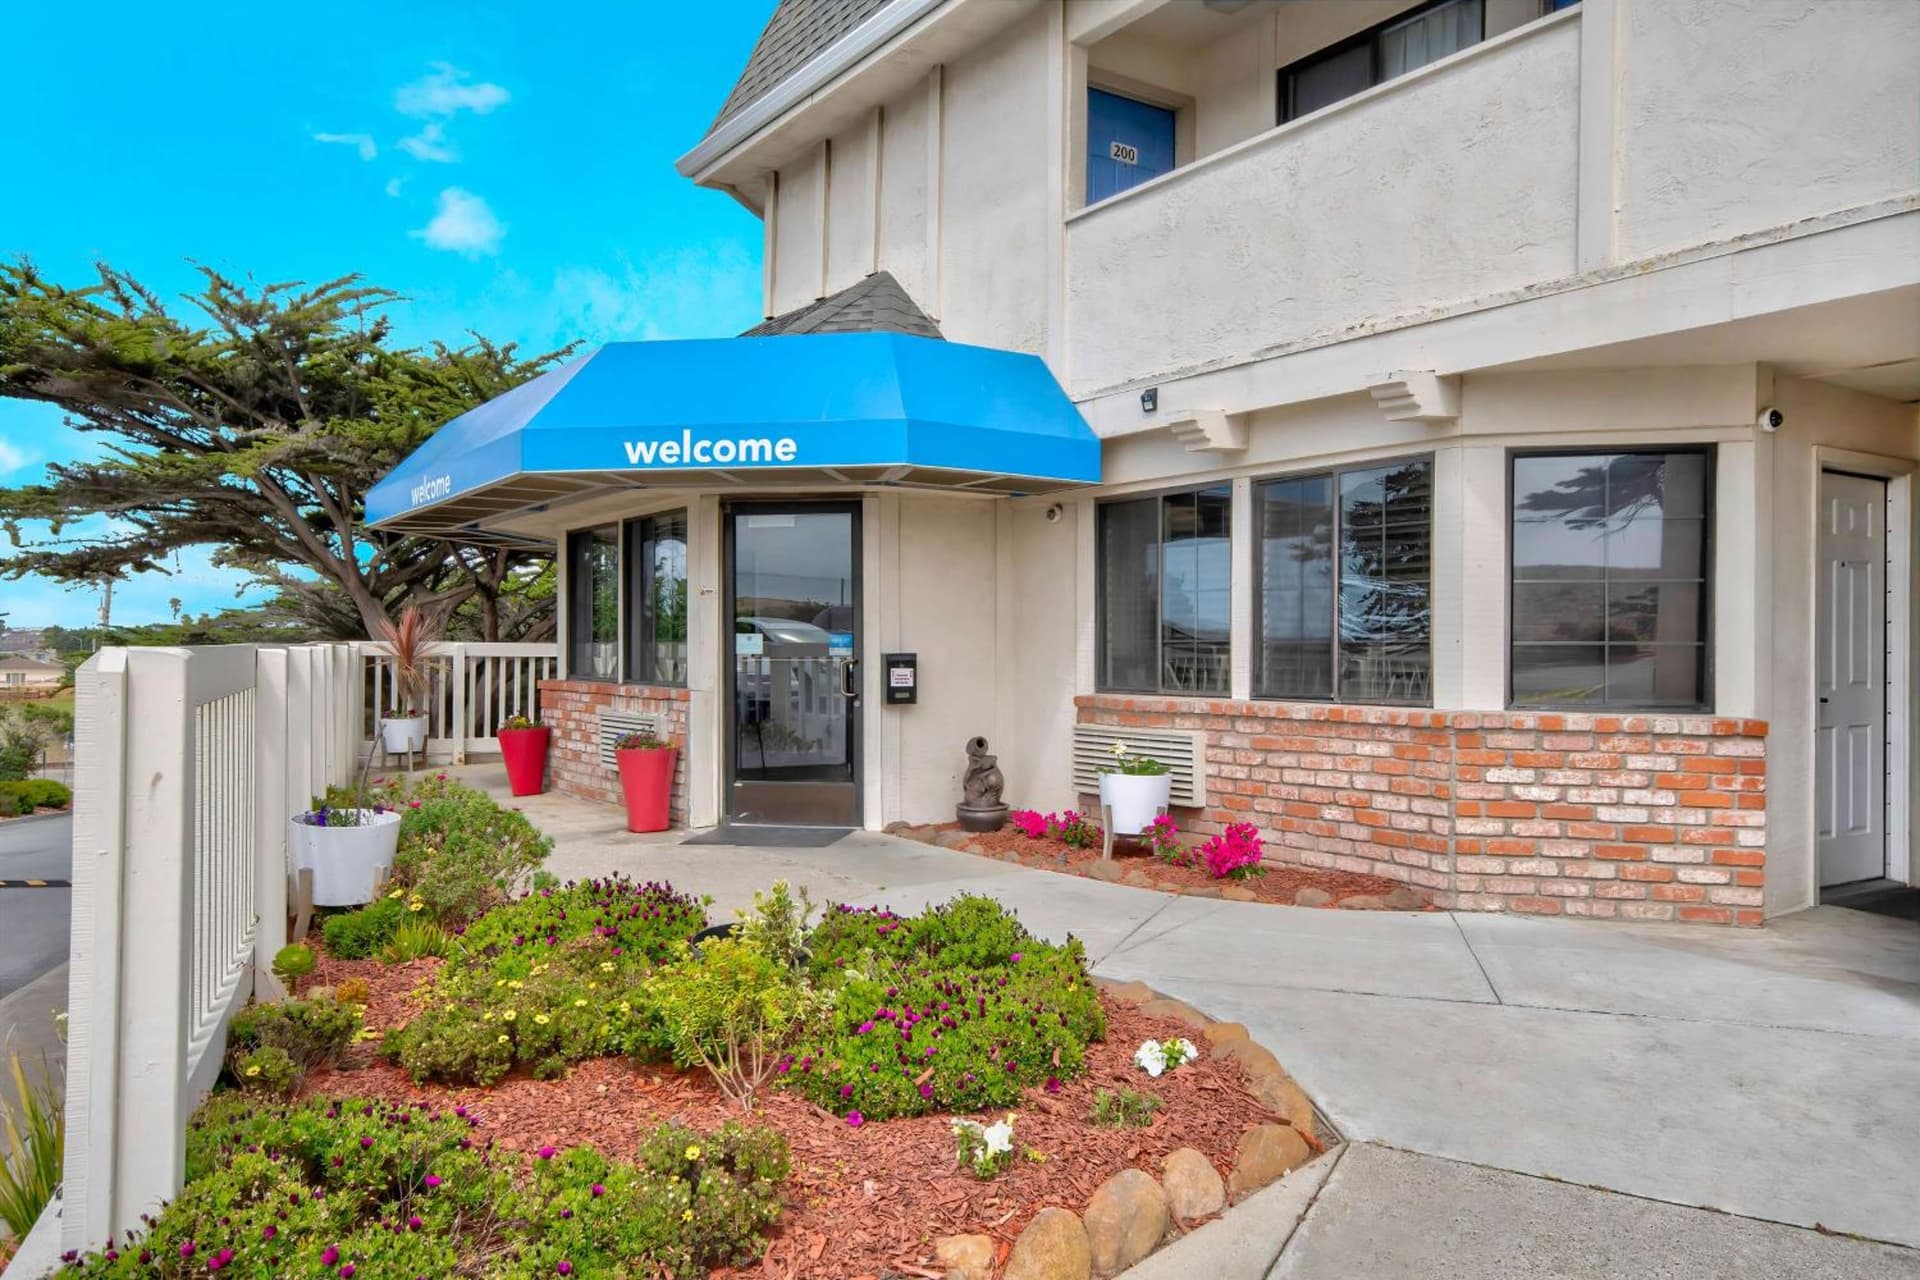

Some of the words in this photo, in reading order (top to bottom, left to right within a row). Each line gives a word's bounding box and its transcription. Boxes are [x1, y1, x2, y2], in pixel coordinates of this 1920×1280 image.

[1113, 144, 1135, 161] 200
[624, 429, 797, 465] welcome
[411, 474, 451, 505] welcome
